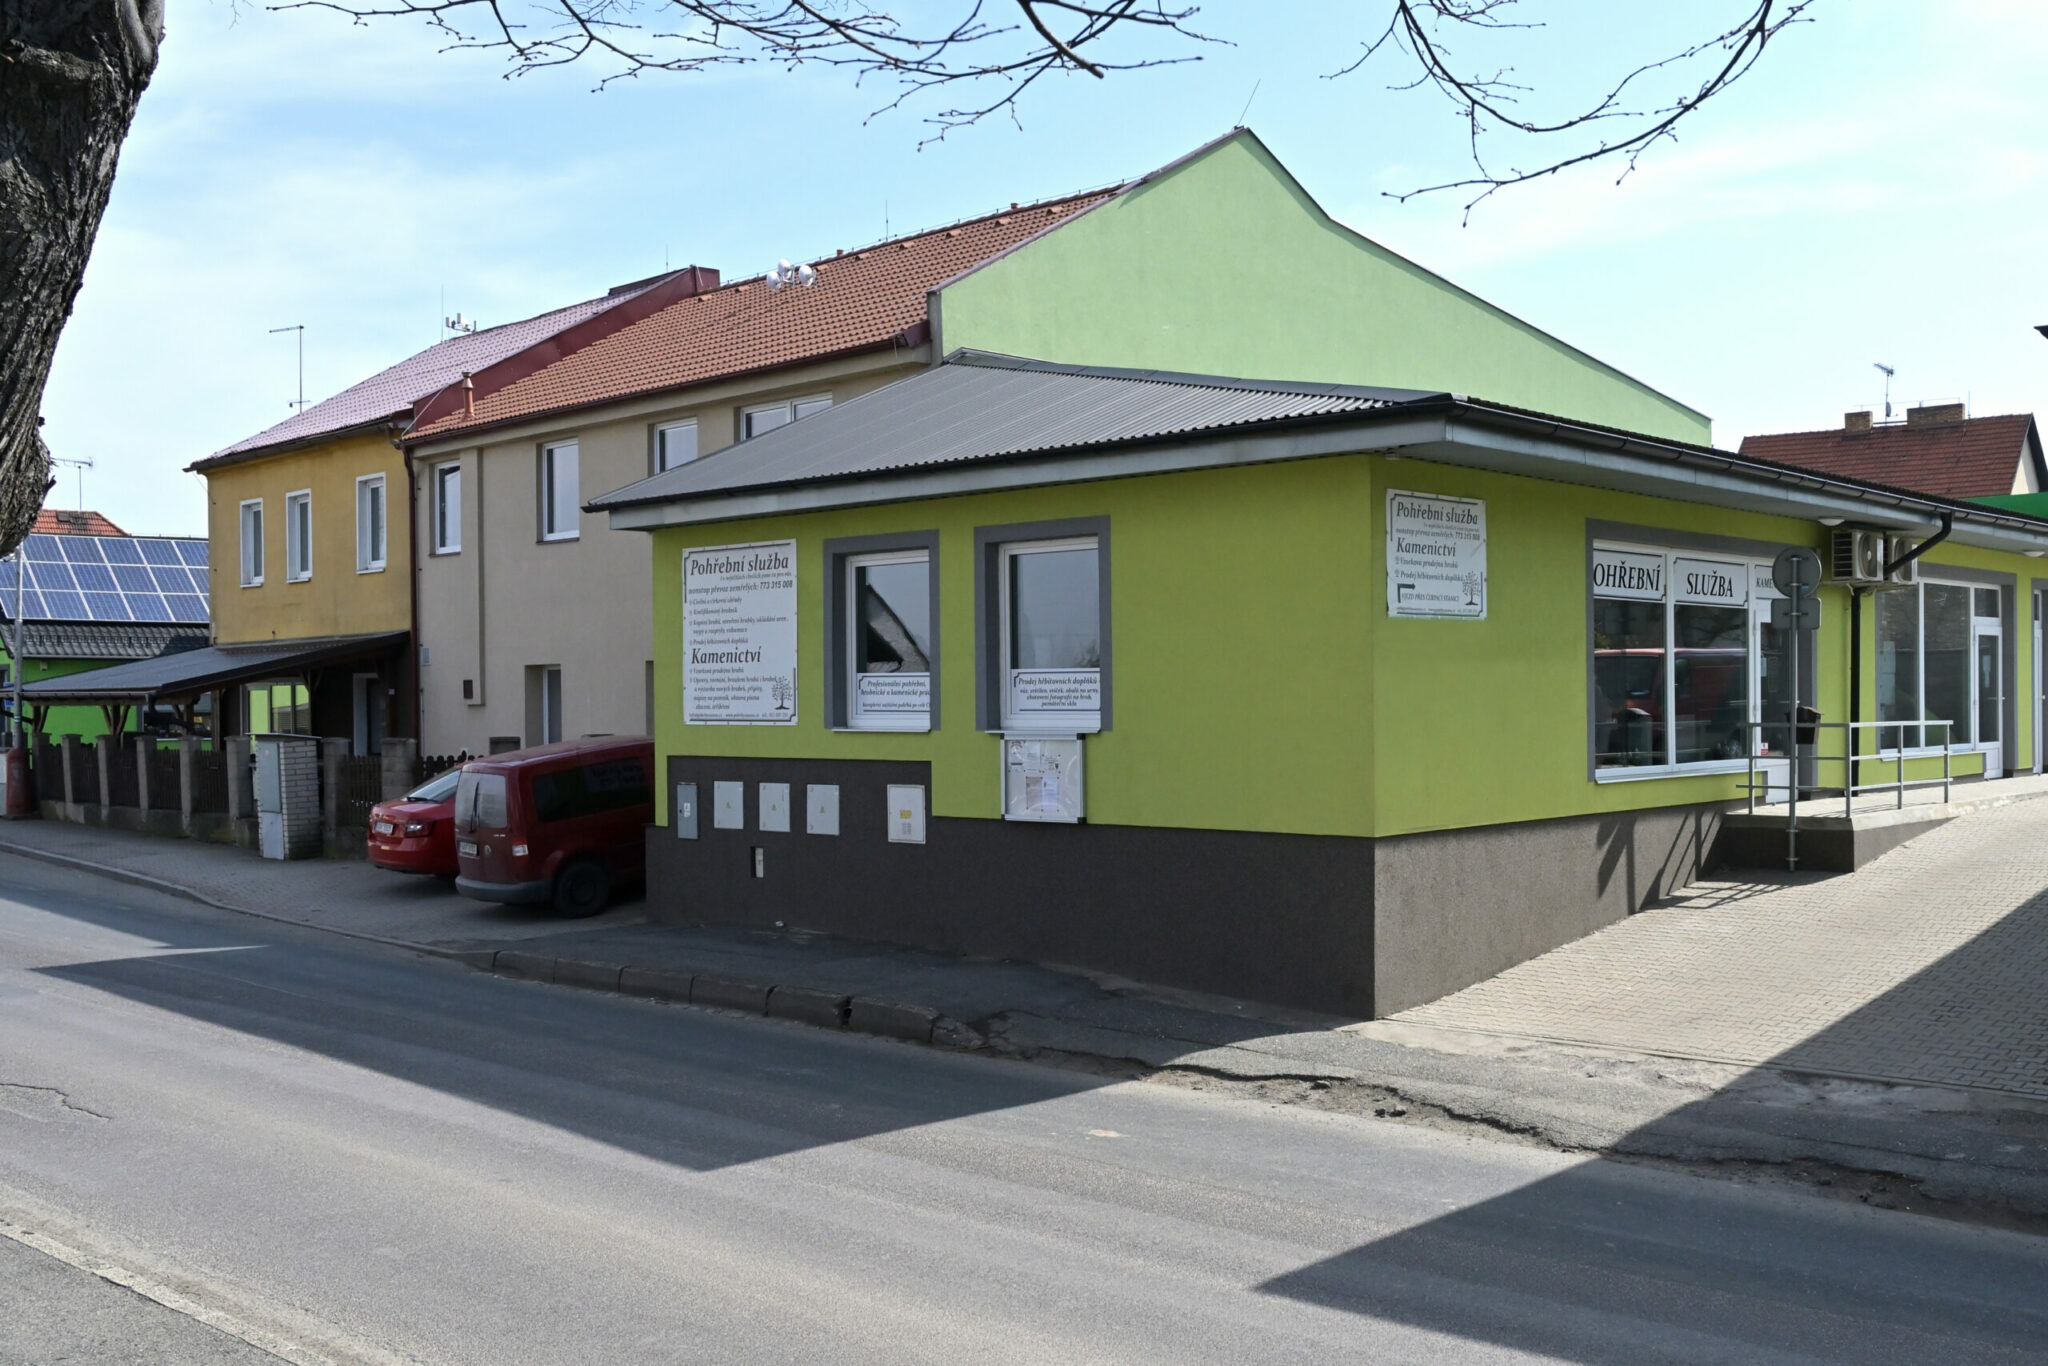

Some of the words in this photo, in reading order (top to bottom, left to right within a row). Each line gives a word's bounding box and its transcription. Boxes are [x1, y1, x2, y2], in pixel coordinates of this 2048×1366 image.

[1396, 502, 1444, 522] Pohřební
[1446, 507, 1478, 524] služba
[1396, 537, 1456, 556] Kamenictví
[690, 555, 746, 576] Pohřební
[748, 552, 789, 572] služba
[760, 581, 770, 590] 773
[1593, 560, 1661, 592] OHŘEBNÍ
[1686, 570, 1734, 598] SLUŽBA
[1756, 578, 1774, 589] KAME
[692, 646, 762, 664] Kamenictví
